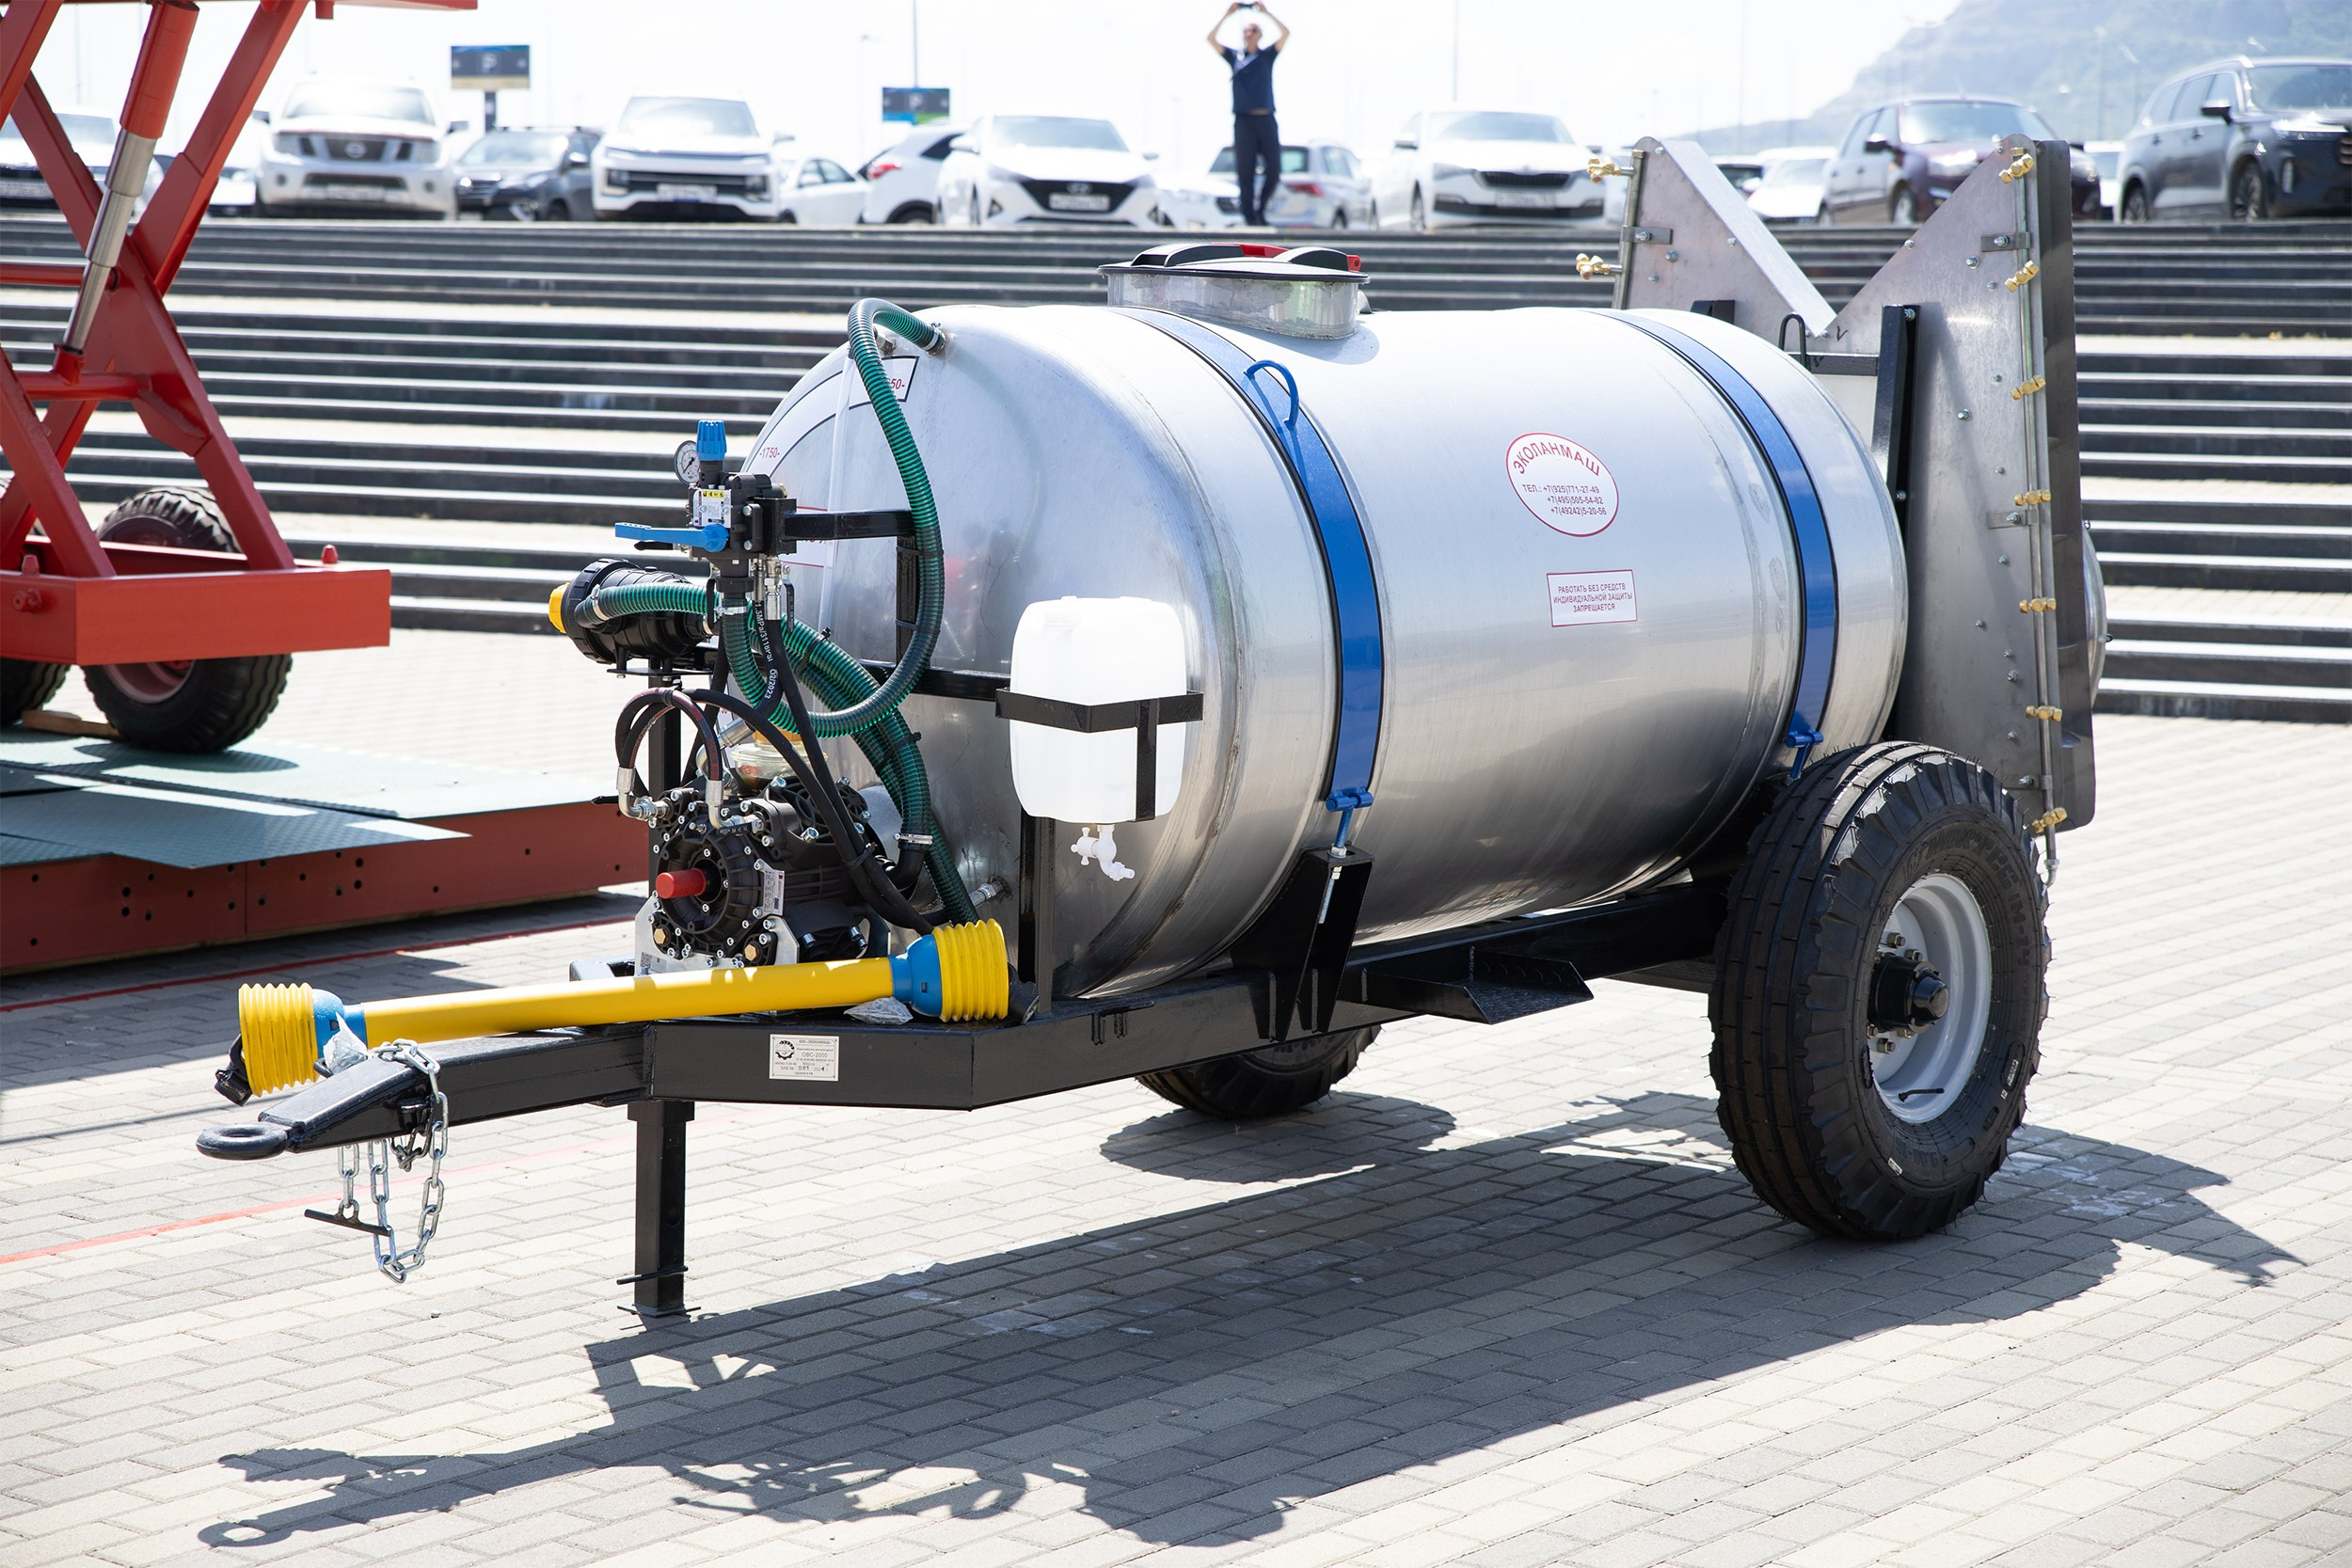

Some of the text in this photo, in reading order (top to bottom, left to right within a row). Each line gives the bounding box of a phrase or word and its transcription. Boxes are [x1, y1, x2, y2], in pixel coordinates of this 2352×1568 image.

[889, 378, 905, 390] 50-
[1513, 441, 1600, 477] ЭКОЛАНМАШ
[1543, 485, 1600, 495] +7(925)771-27-49
[1547, 496, 1604, 506] +7(495)505-54-82
[1558, 582, 1627, 594] РАБОТАТЬ БЕЗ СРЕДСТВ
[1553, 593, 1633, 604] ИНДИВИДУАЛЬНОЙ ЗАЩИТЫ
[1573, 603, 1616, 612] ЗАПРЕЩАЕТСЯ
